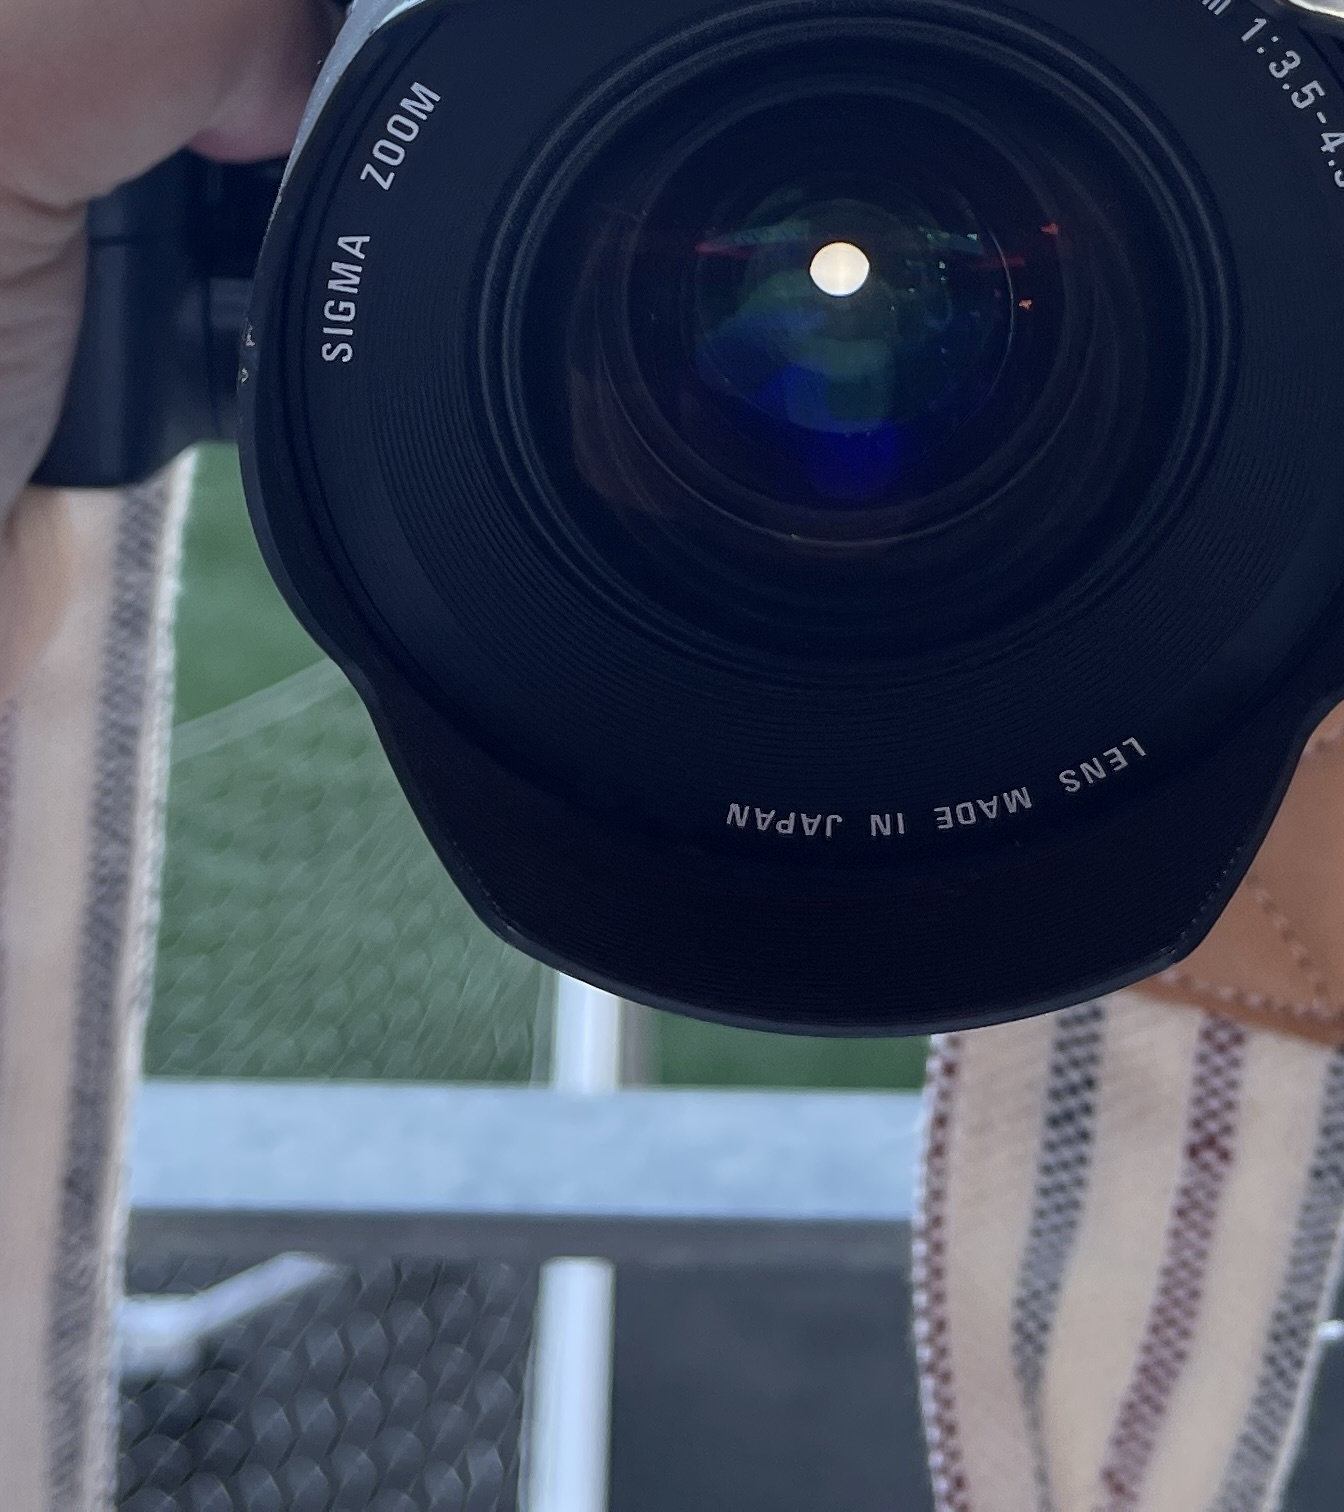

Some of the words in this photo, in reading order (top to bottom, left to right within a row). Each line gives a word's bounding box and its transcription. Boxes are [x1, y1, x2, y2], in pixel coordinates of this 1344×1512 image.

[321, 235, 371, 363] SIGMA
[359, 81, 441, 191] ZOOM
[1058, 736, 1147, 793] LENS
[726, 802, 843, 838] JAPAN
[870, 812, 905, 837] IN
[933, 786, 1033, 830] MADE
